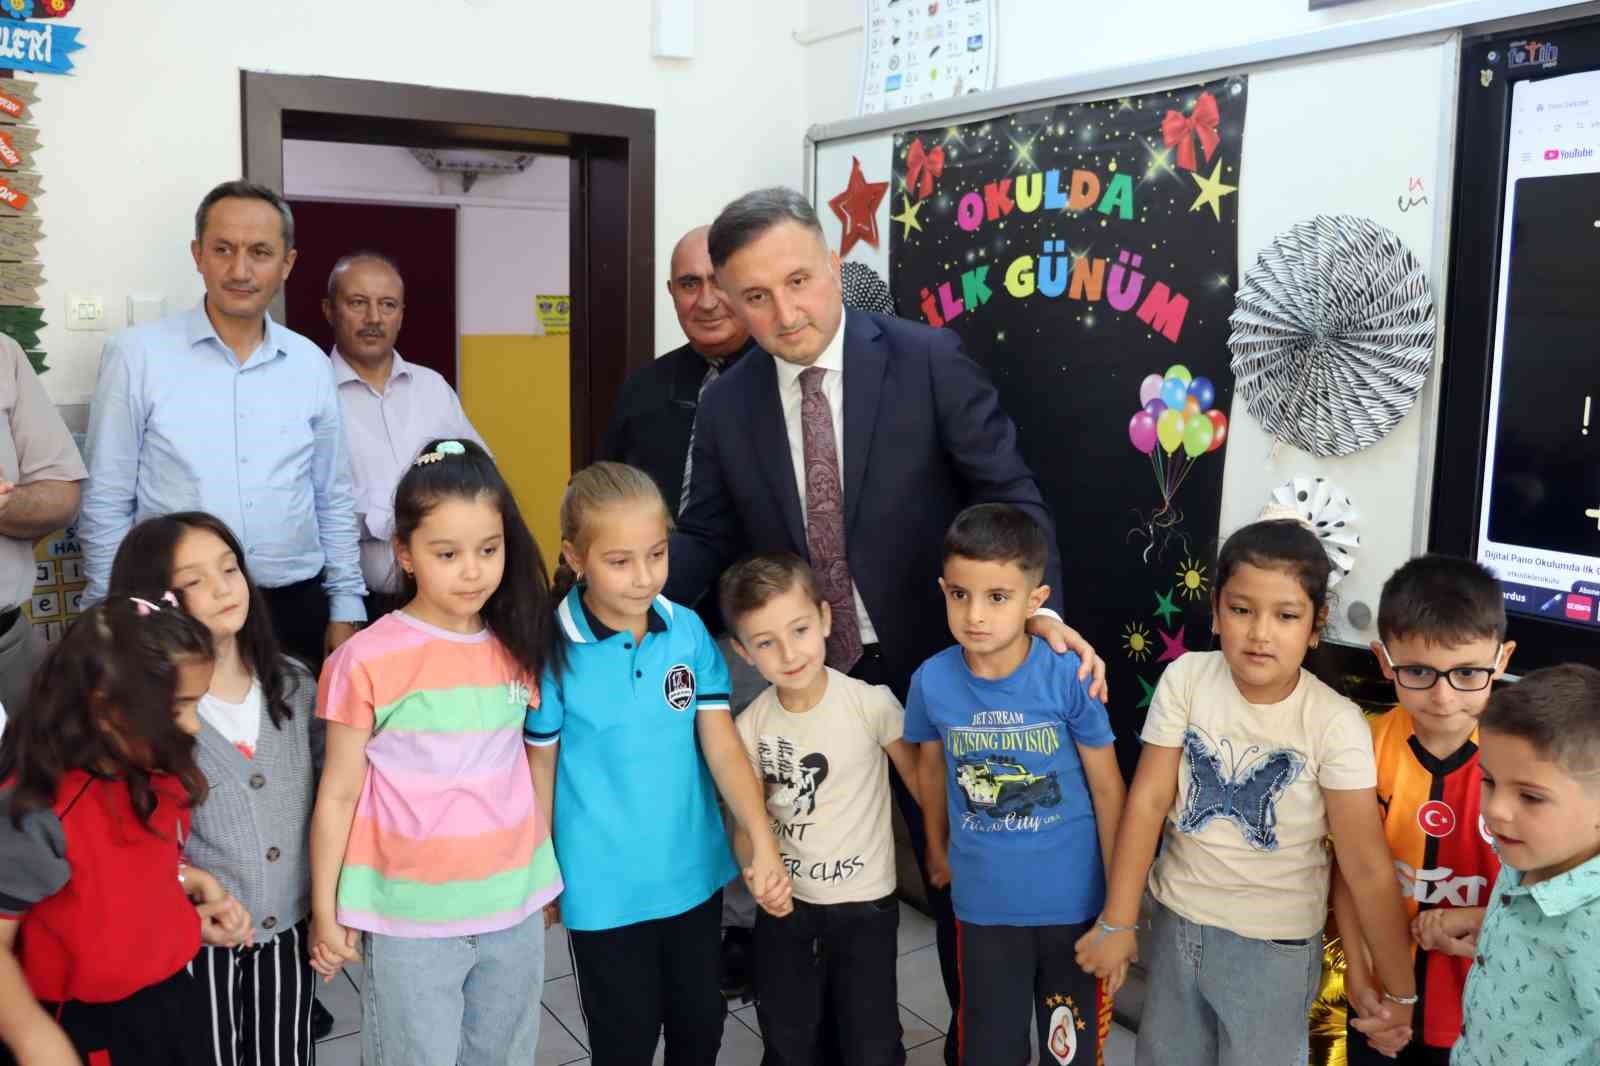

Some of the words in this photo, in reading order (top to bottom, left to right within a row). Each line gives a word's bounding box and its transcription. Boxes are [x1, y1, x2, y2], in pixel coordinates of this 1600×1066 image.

[957, 168, 1133, 231] OKULDA
[919, 265, 992, 328] İLK
[1003, 239, 1189, 343] GÜNÜM
[988, 711, 1024, 726] STREAM
[1002, 727, 1059, 755] DIVISION
[810, 855, 864, 881] CLASS
